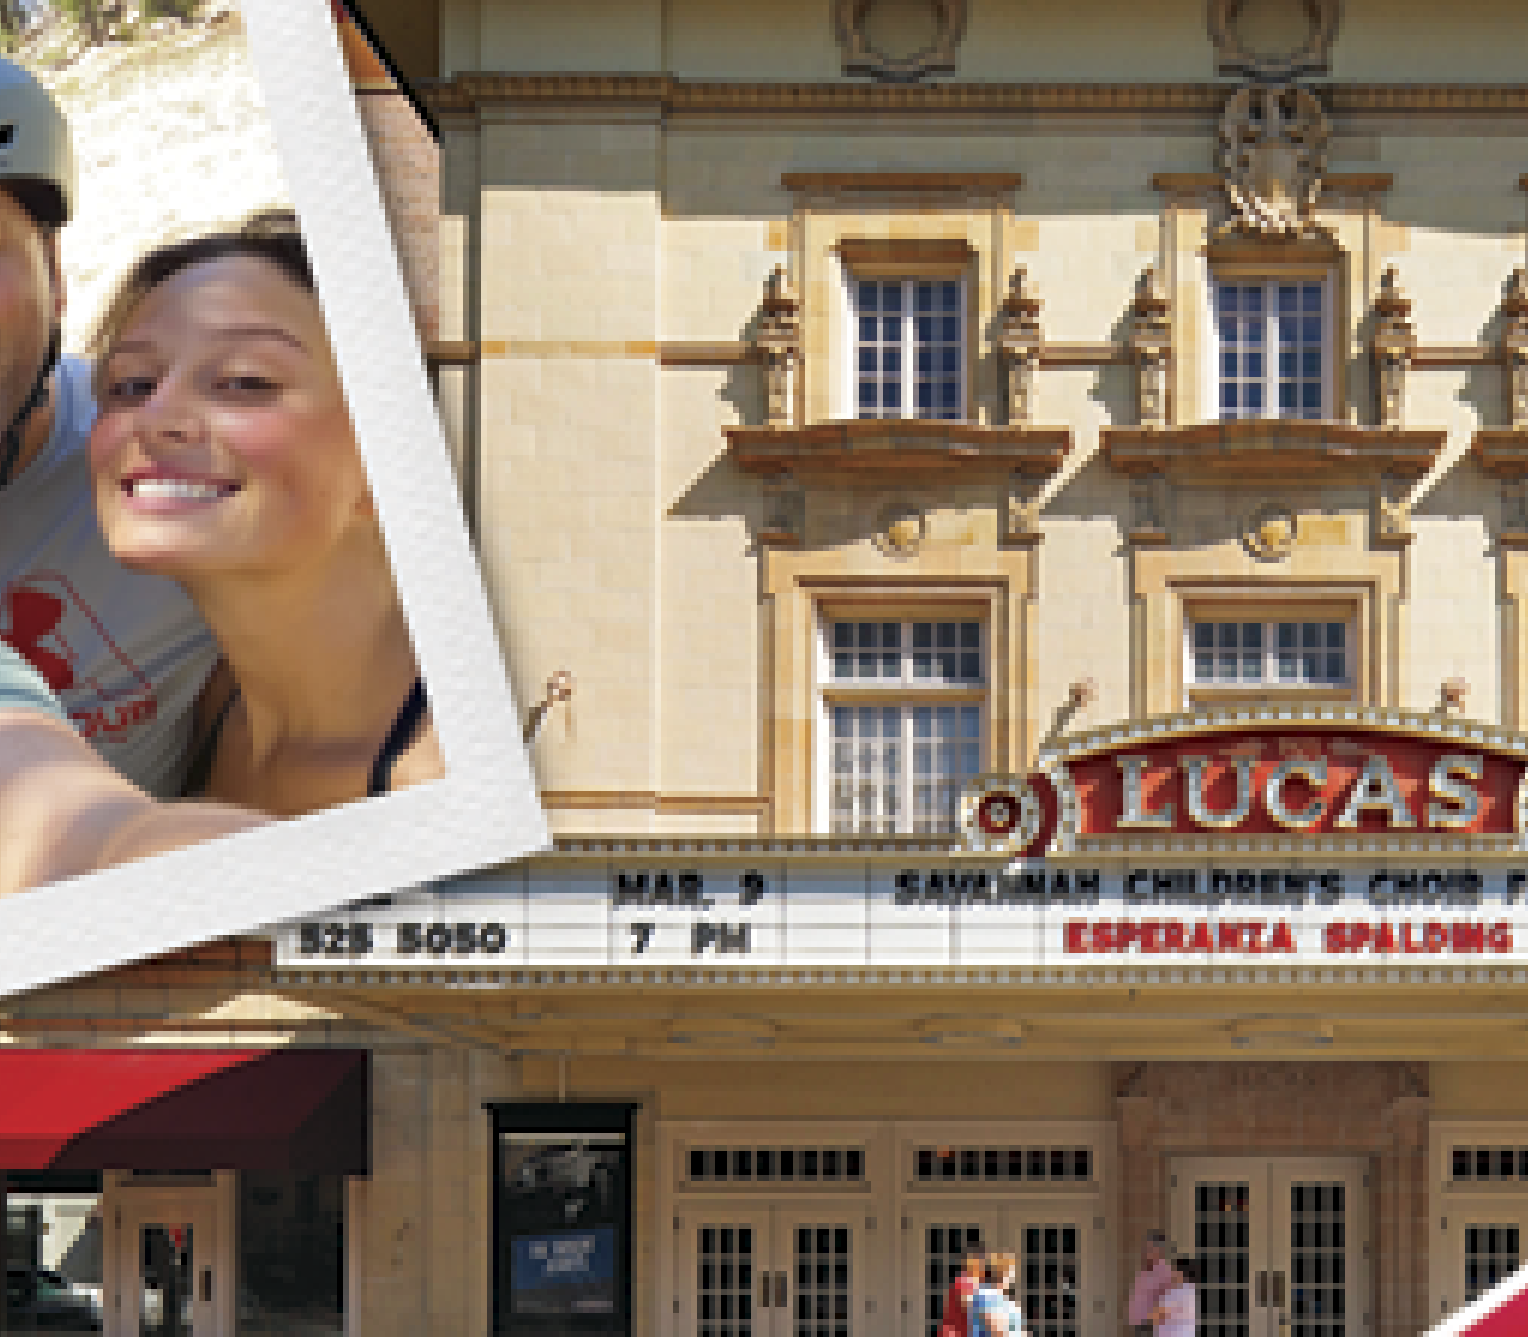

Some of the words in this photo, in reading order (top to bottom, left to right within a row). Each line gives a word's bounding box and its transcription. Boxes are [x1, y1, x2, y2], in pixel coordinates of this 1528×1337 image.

[1114, 752, 1486, 830] LUCAS
[615, 871, 714, 908] MAR.
[740, 871, 767, 906] 9
[1125, 869, 1342, 905] CHILDREN'S
[1367, 869, 1482, 905] CHOIR
[298, 922, 374, 955] 525
[397, 922, 508, 955] 5050
[630, 922, 658, 955] 7
[691, 922, 752, 955] PM
[1062, 918, 1297, 955] ESPERANZA
[1324, 918, 1513, 955] SPALDING
